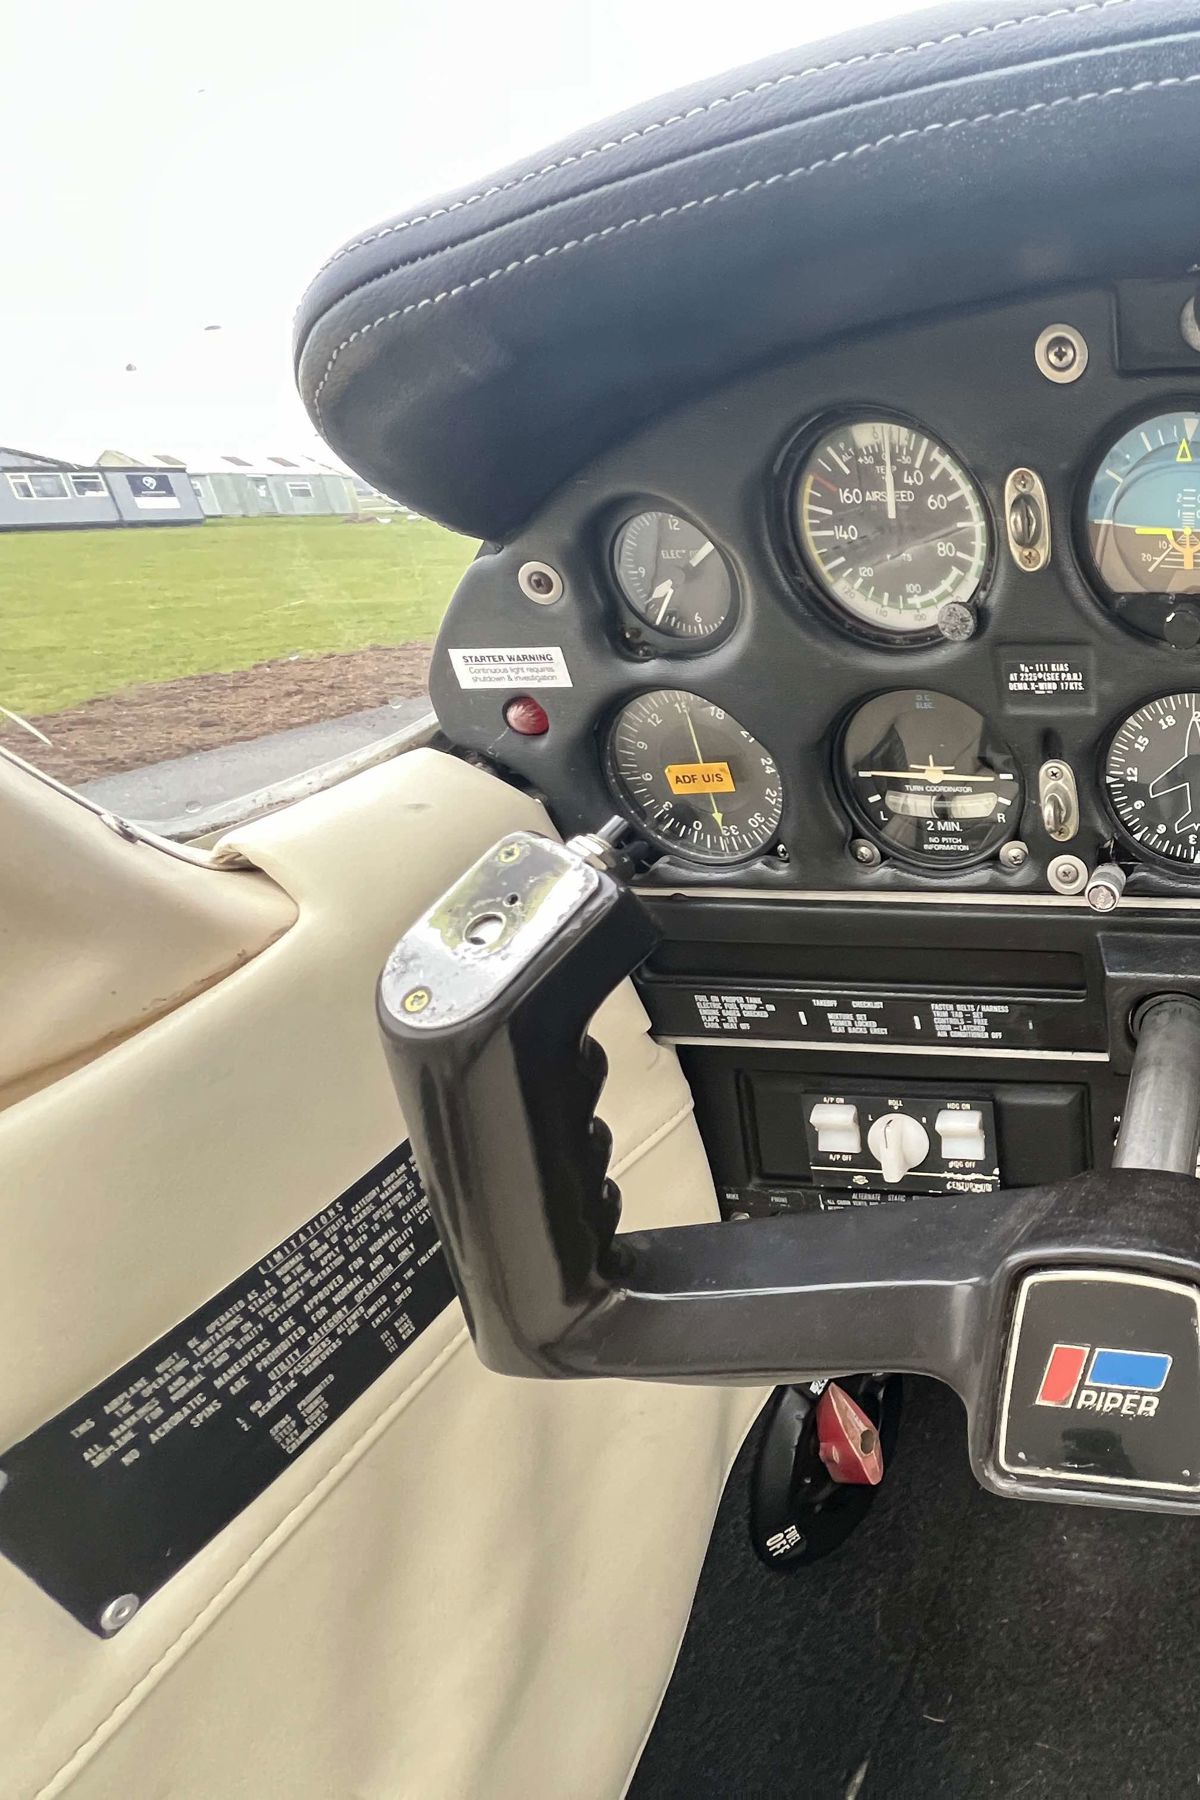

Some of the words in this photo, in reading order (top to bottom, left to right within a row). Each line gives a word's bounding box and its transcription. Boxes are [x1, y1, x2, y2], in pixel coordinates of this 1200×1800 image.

[904, 470, 923, 485] 40
[839, 488, 862, 504] 160
[928, 495, 947, 510] 60
[668, 519, 680, 530] 12
[834, 526, 858, 540] 140
[937, 542, 955, 556] 80
[859, 567, 873, 577] 120
[905, 584, 921, 593] 100
[462, 655, 505, 663] STARTER
[469, 666, 508, 674] Continuous
[526, 666, 555, 674] requires
[515, 674, 557, 682] investigation
[1159, 715, 1176, 730] 18
[1134, 735, 1149, 752] 15
[675, 776, 698, 784] ADF
[702, 773, 724, 782] U/S
[1127, 767, 1137, 782] 12
[925, 785, 972, 793] COORDINATOR
[880, 811, 888, 820] L
[997, 814, 1006, 822] R
[927, 821, 934, 830] 2
[852, 1193, 880, 1201] ALTERNATE
[324, 1216, 347, 1238] UTILITY
[351, 1186, 380, 1214] CATEGORY
[320, 1246, 341, 1267] APPLY
[248, 1286, 278, 1313] STATED
[212, 1338, 272, 1390] MANEUVERS
[278, 1315, 297, 1336] ARE
[302, 1274, 345, 1314] APPROVED
[348, 1256, 366, 1274] FOR
[368, 1226, 398, 1254] NORMAL
[190, 1399, 222, 1428] SPINS
[255, 1325, 307, 1372] PROHIBITED
[310, 1306, 329, 1324] FOR
[332, 1274, 365, 1306] NORMAL
[368, 1254, 385, 1272] AND
[388, 1226, 414, 1253] UTILITY
[267, 1348, 301, 1381] UTILITY
[307, 1305, 350, 1346] CATEGORY
[354, 1263, 395, 1303] OPERATION
[1077, 1390, 1159, 1417] PIPER
[784, 1525, 801, 1546] FUEL
[766, 1532, 790, 1556] OFF
